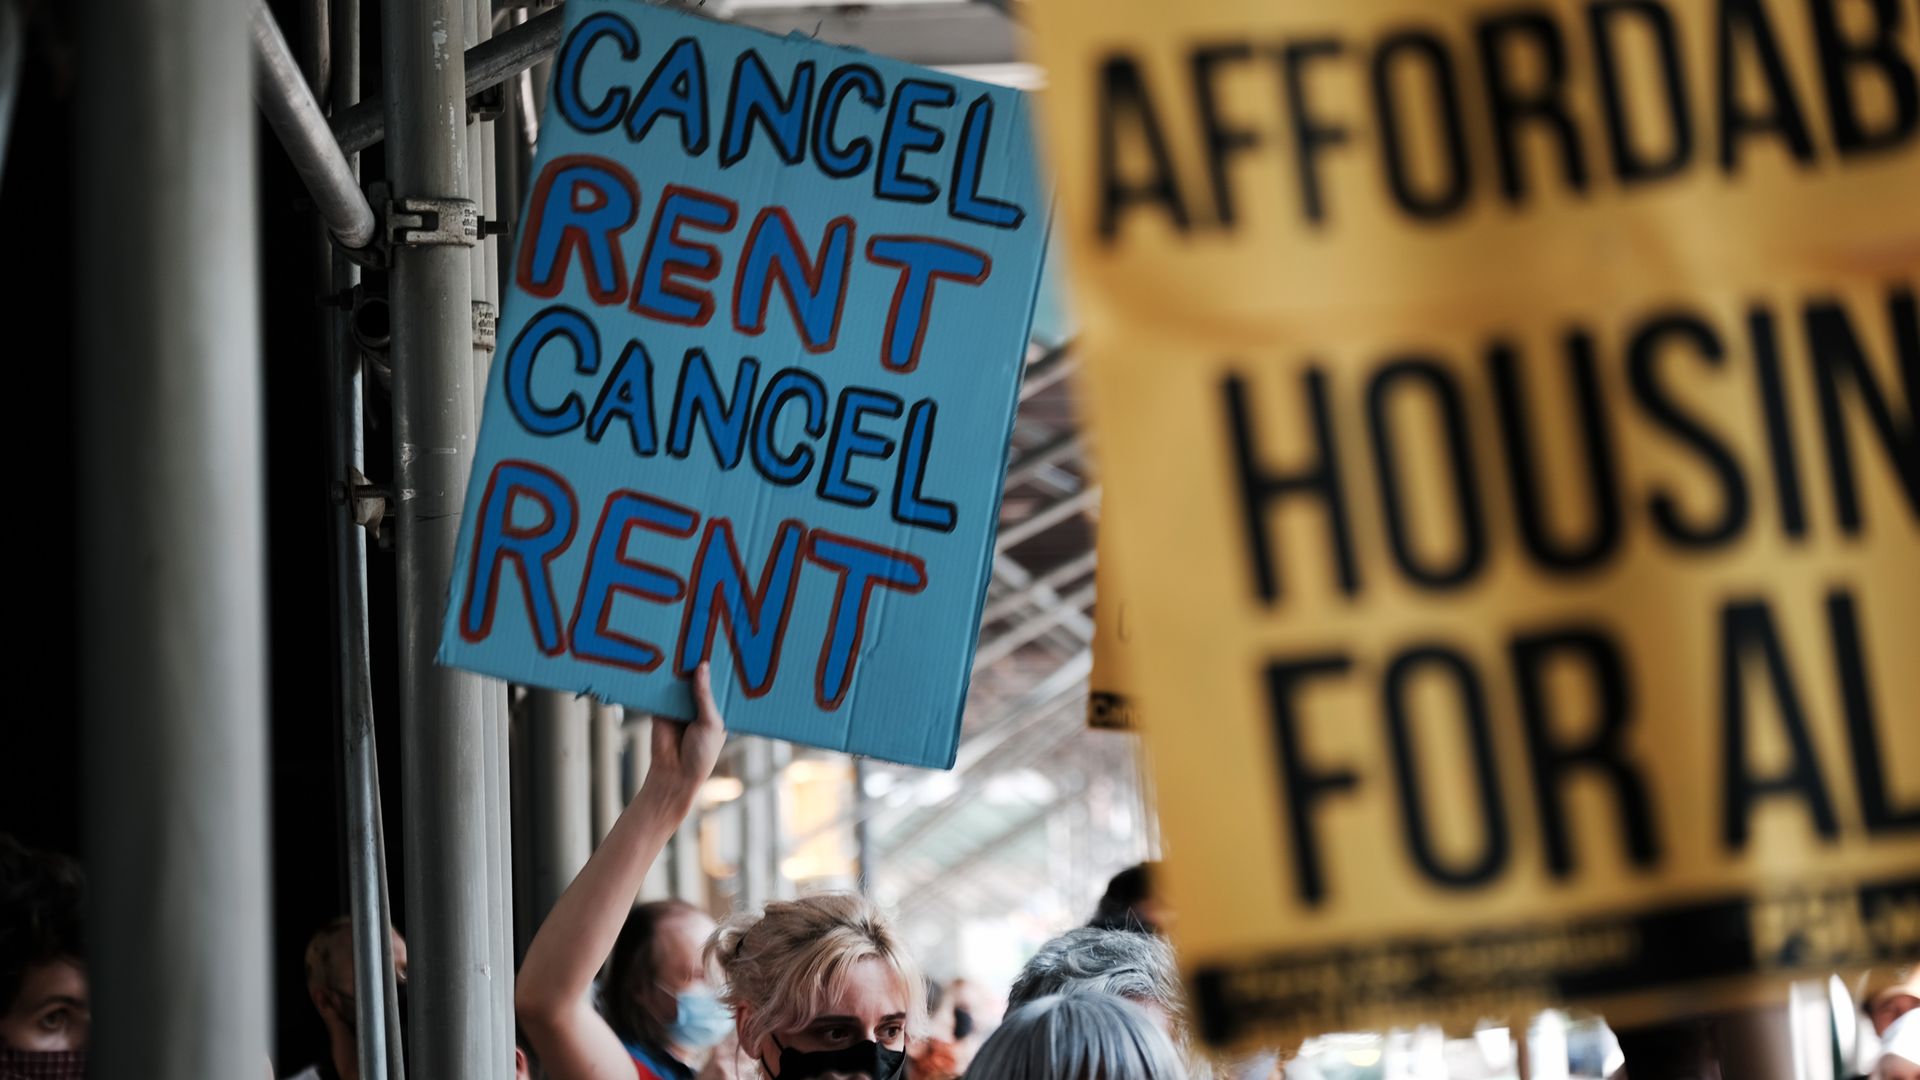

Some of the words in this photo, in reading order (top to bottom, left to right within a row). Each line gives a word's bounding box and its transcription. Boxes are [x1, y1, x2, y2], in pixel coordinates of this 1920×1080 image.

[554, 12, 1025, 230] CANCEL
[1092, 0, 1920, 242] AFFORDAB
[516, 154, 992, 374] RENT
[504, 304, 958, 534] CANCEL
[1216, 282, 1920, 608] HOUSIN
[459, 459, 928, 712] RENT
[1263, 622, 1662, 911] FOR
[1719, 588, 1920, 852] AL
